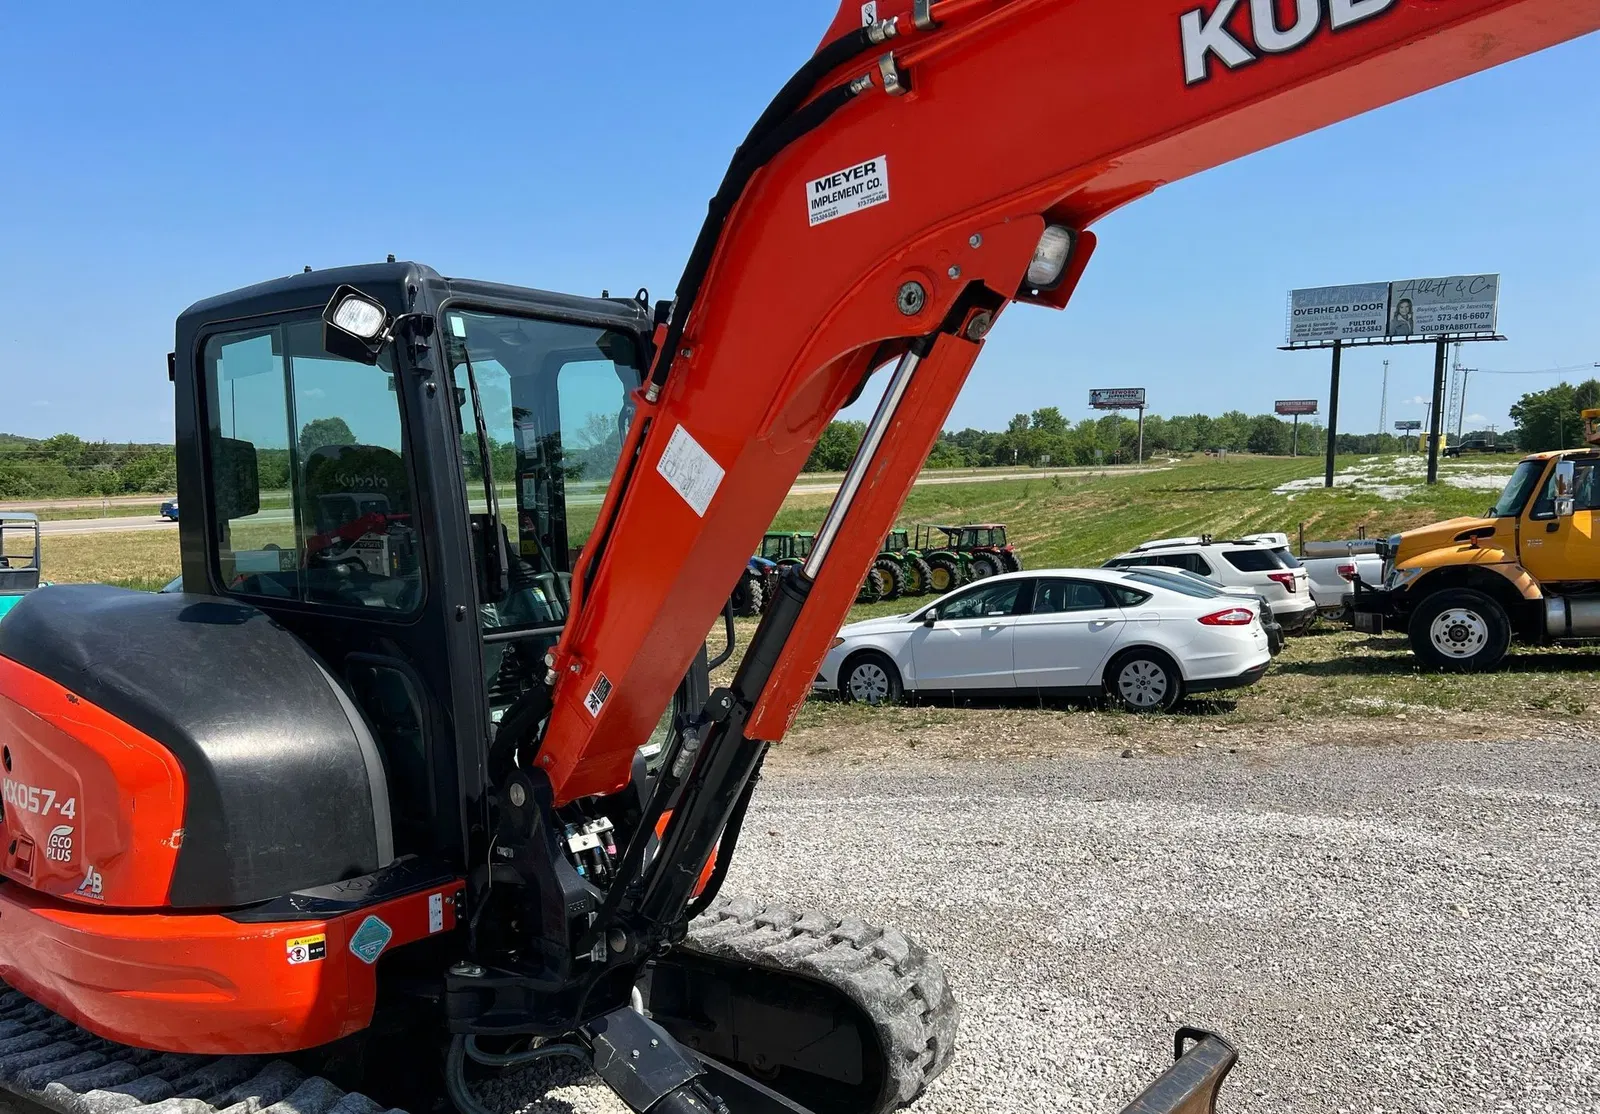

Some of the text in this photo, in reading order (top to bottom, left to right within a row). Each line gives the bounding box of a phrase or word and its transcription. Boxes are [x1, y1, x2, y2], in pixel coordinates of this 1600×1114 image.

[814, 161, 877, 194] MEYER
[811, 182, 864, 210] IMPLEMENT
[866, 177, 882, 191] CO.
[1397, 276, 1496, 300] Abbott & Co
[1293, 303, 1384, 316] OVERHEAD DOOR
[1437, 311, 1490, 321] 573-416-6607
[1341, 325, 1383, 334] 573-642-5843
[1348, 319, 1376, 327] FULTON
[335, 473, 389, 488] Kubota
[3, 778, 76, 819] KX057-4
[46, 847, 72, 862] PLUS
